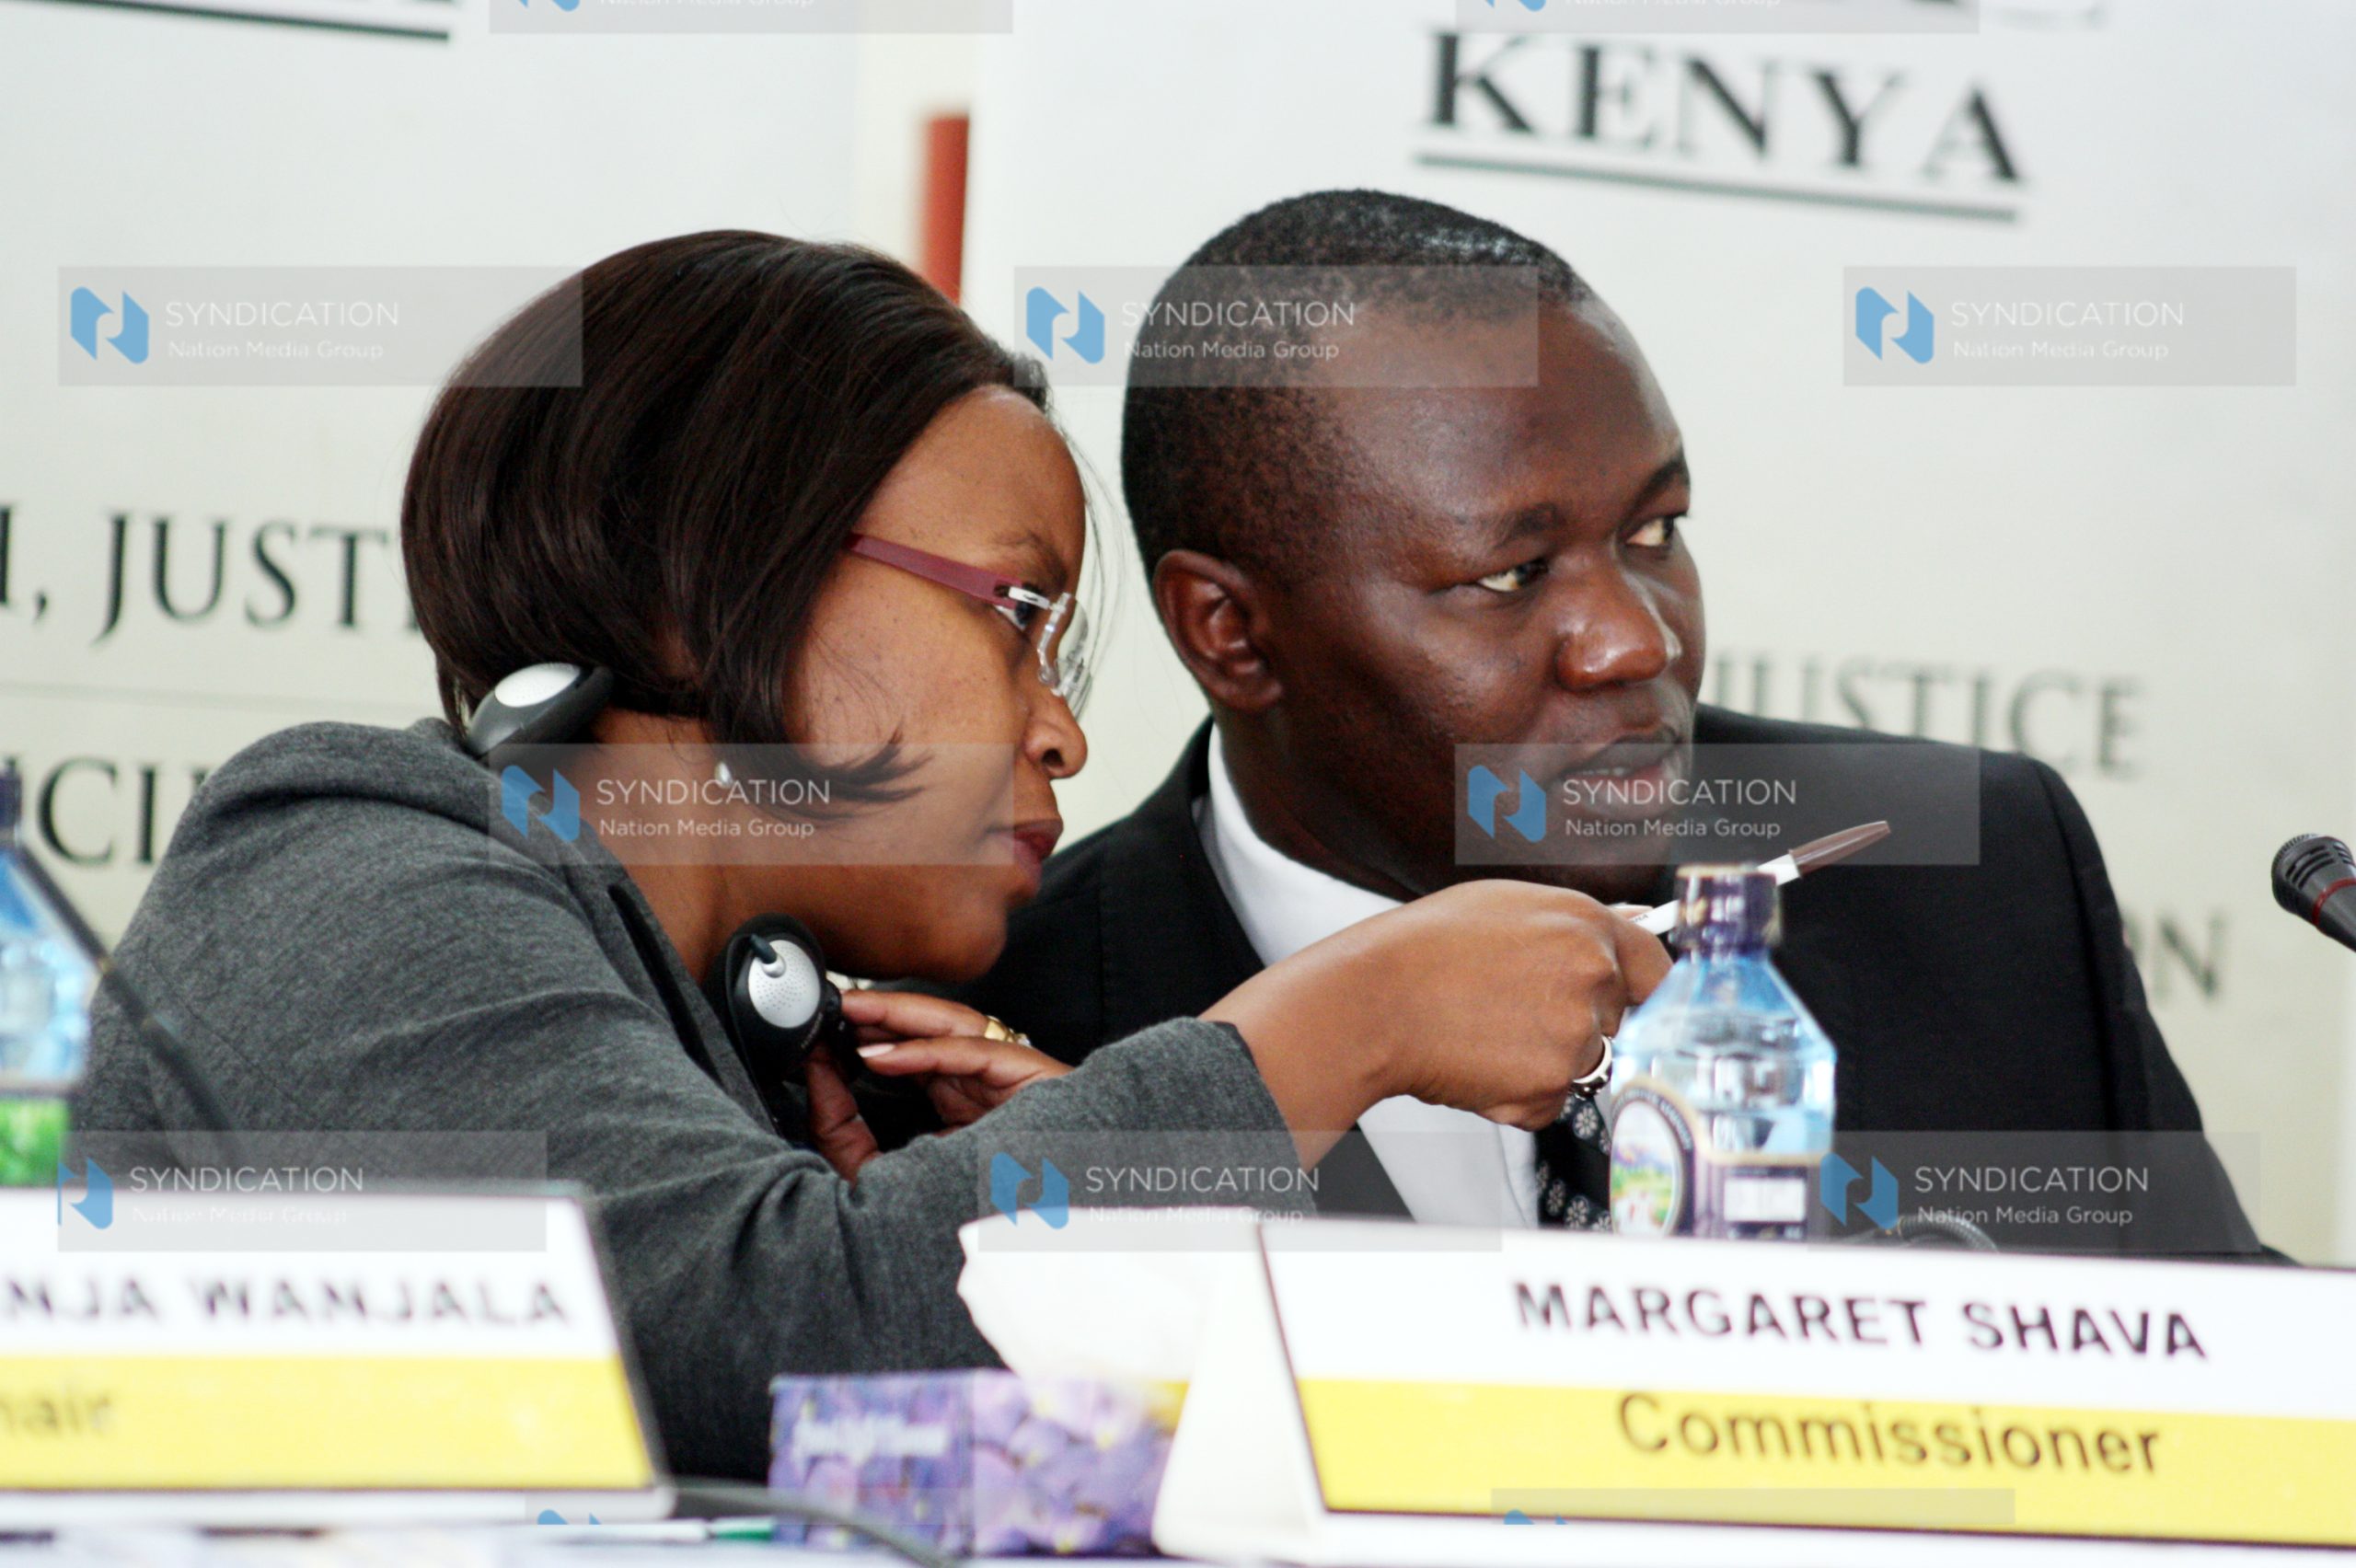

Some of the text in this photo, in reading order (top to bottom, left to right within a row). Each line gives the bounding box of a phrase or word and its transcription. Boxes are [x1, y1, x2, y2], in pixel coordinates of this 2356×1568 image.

[1426, 30, 2027, 184] KENYA
[89, 511, 420, 646] JUST
[189, 1275, 571, 1325] WANJALA
[1512, 1282, 2208, 1360] MARGARET SHAVA
[1617, 1391, 2161, 1474] Commissioner
